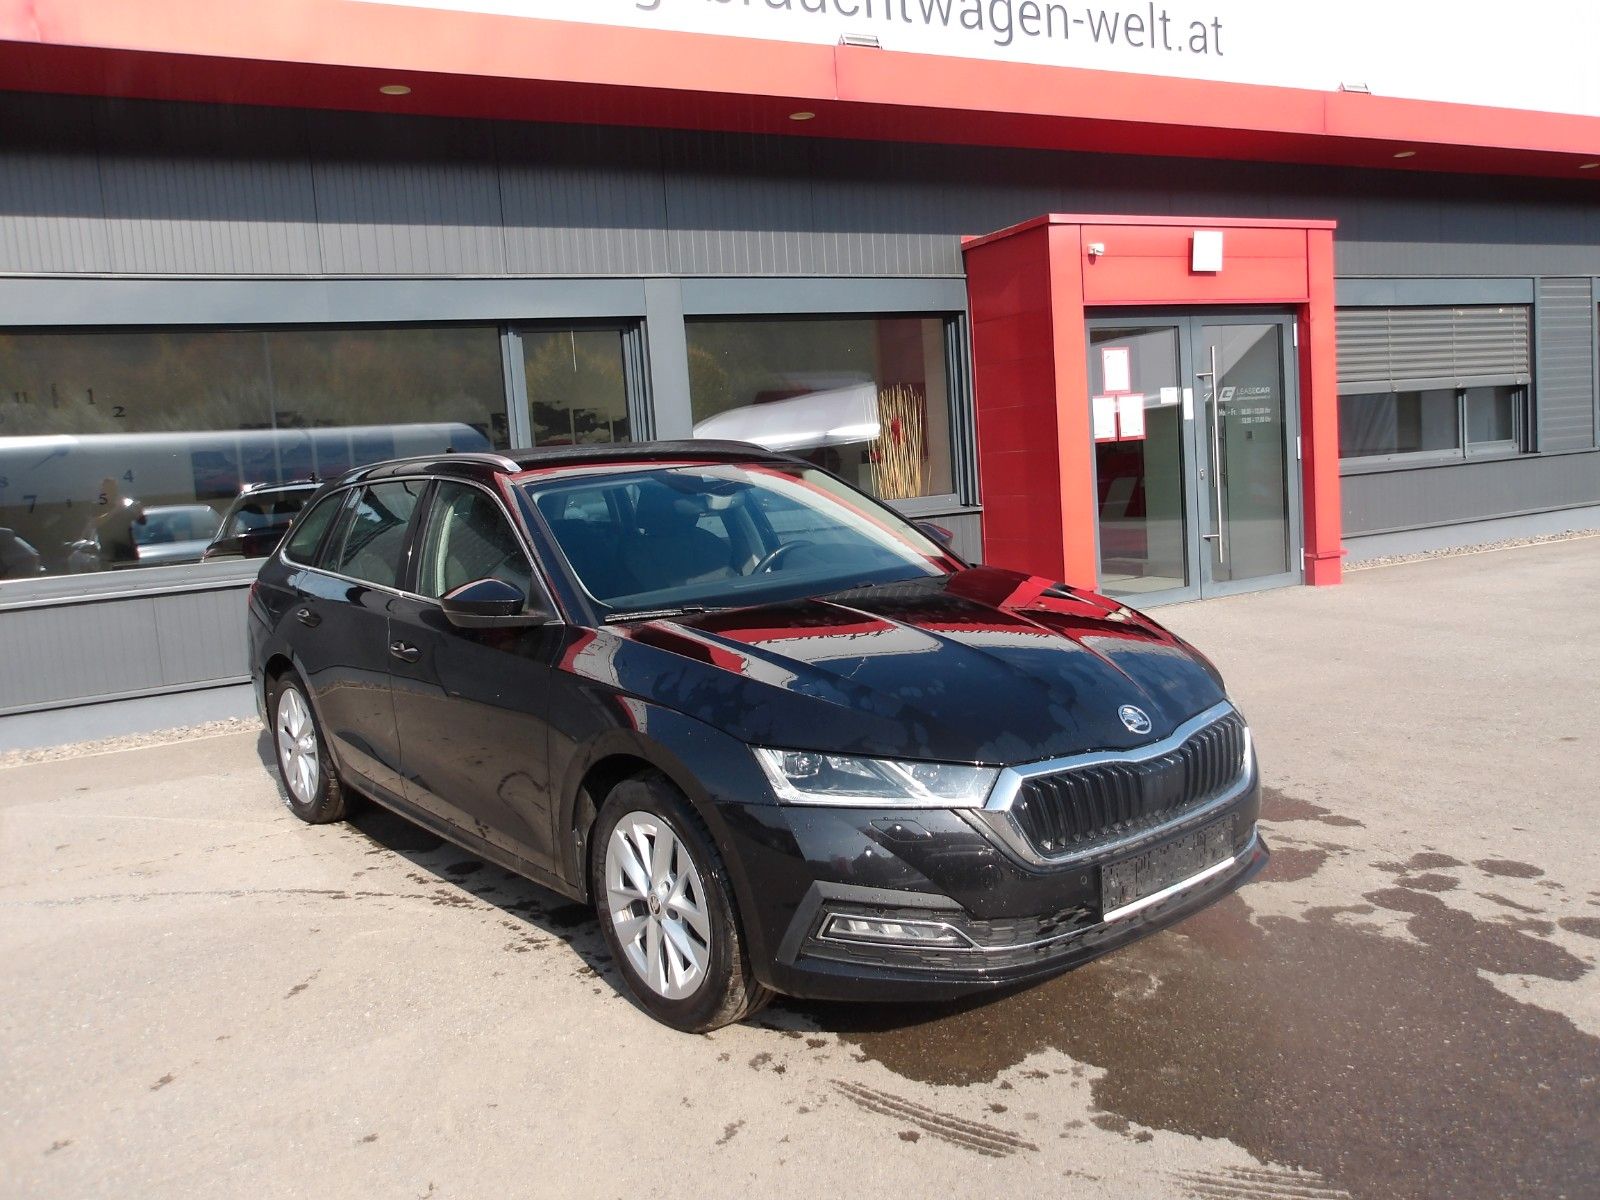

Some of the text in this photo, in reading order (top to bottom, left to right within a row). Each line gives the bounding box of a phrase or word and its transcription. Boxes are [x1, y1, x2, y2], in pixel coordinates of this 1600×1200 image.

[112, 406, 126, 417] 2
[123, 469, 134, 482] 4
[24, 494, 37, 513] 7
[98, 493, 108, 505] 5
